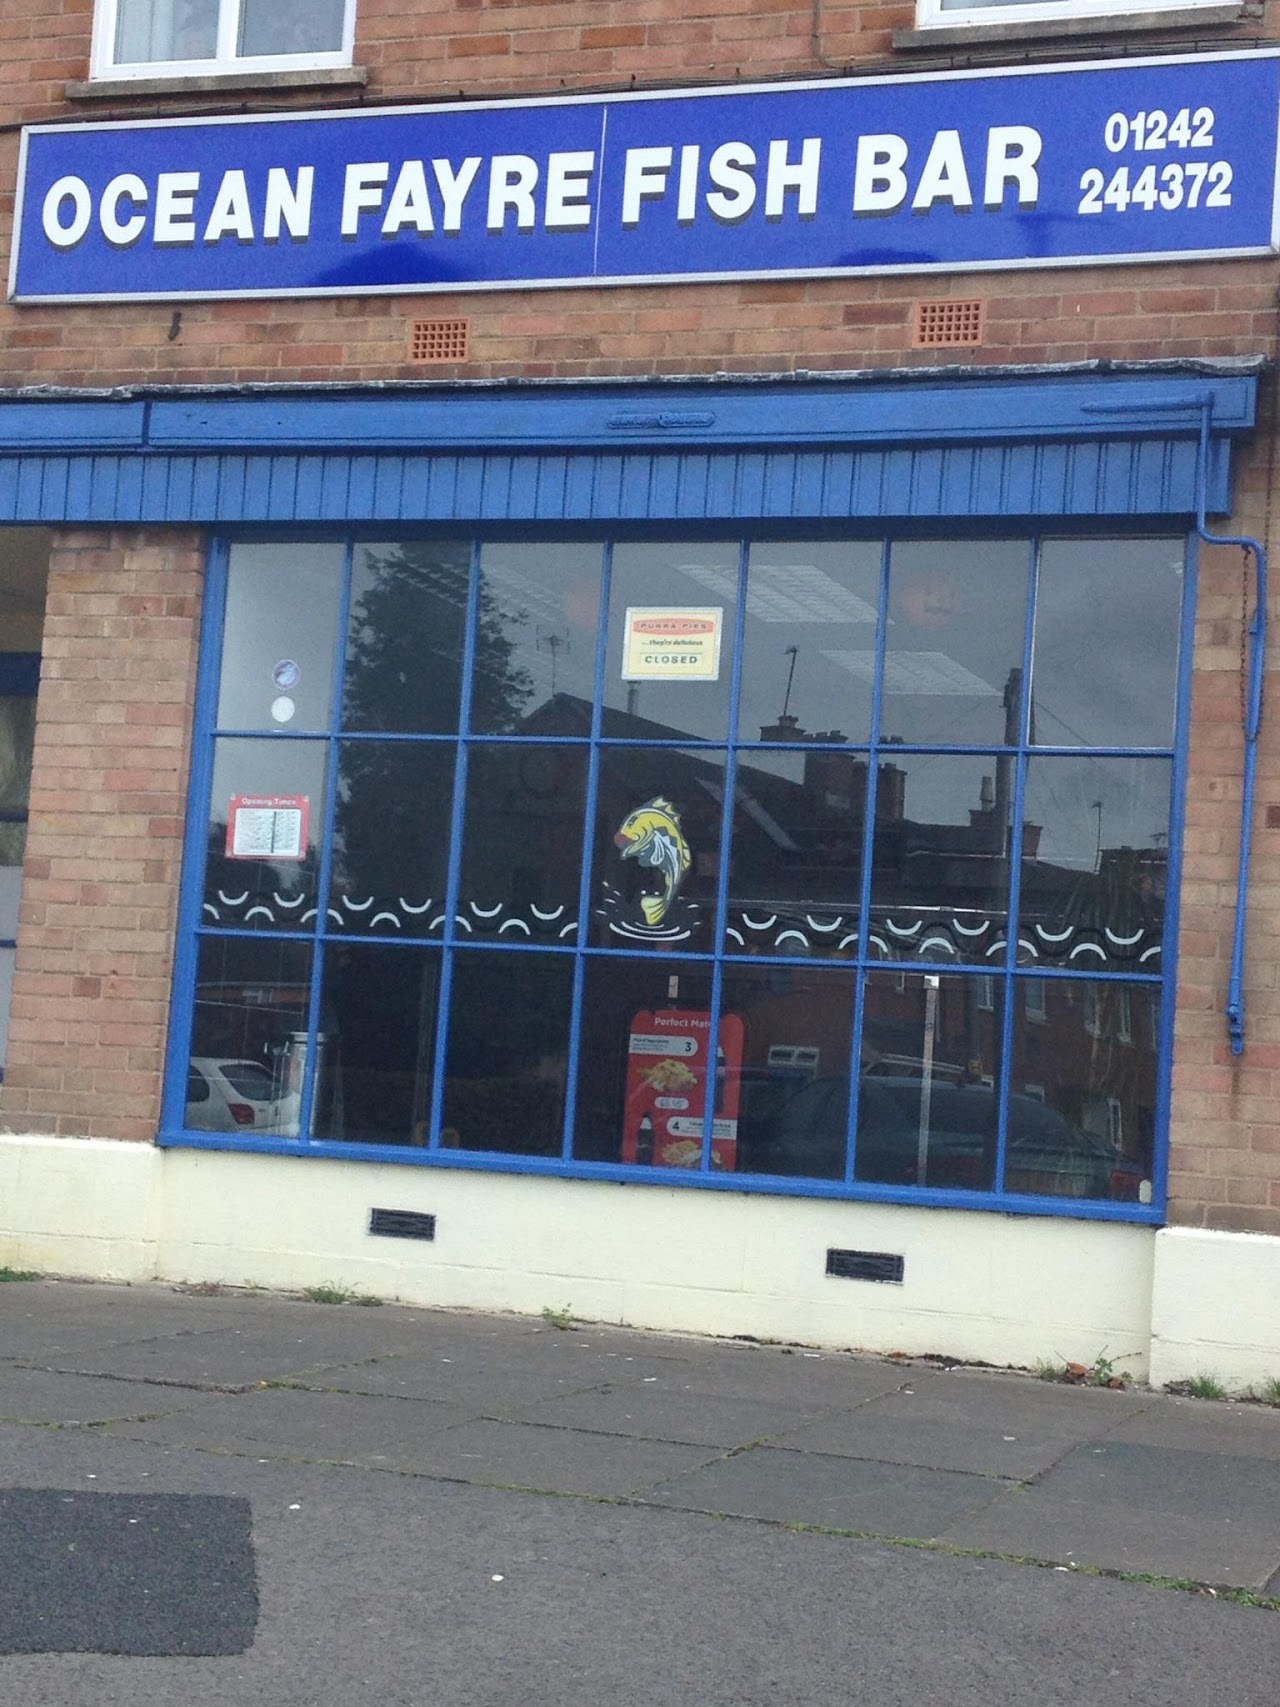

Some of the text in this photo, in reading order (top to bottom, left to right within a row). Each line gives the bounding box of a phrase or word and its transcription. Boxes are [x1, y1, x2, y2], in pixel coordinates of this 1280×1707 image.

[1104, 106, 1216, 153] 01242
[42, 125, 1043, 247] OCEAN FAYRE FISH BAR
[1078, 160, 1233, 215] 244372
[644, 655, 698, 664] CLOSED
[241, 797, 297, 807] Opening Times
[654, 1017, 688, 1028] Perfect
[684, 1041, 692, 1052] 3
[672, 1121, 680, 1131] 4
